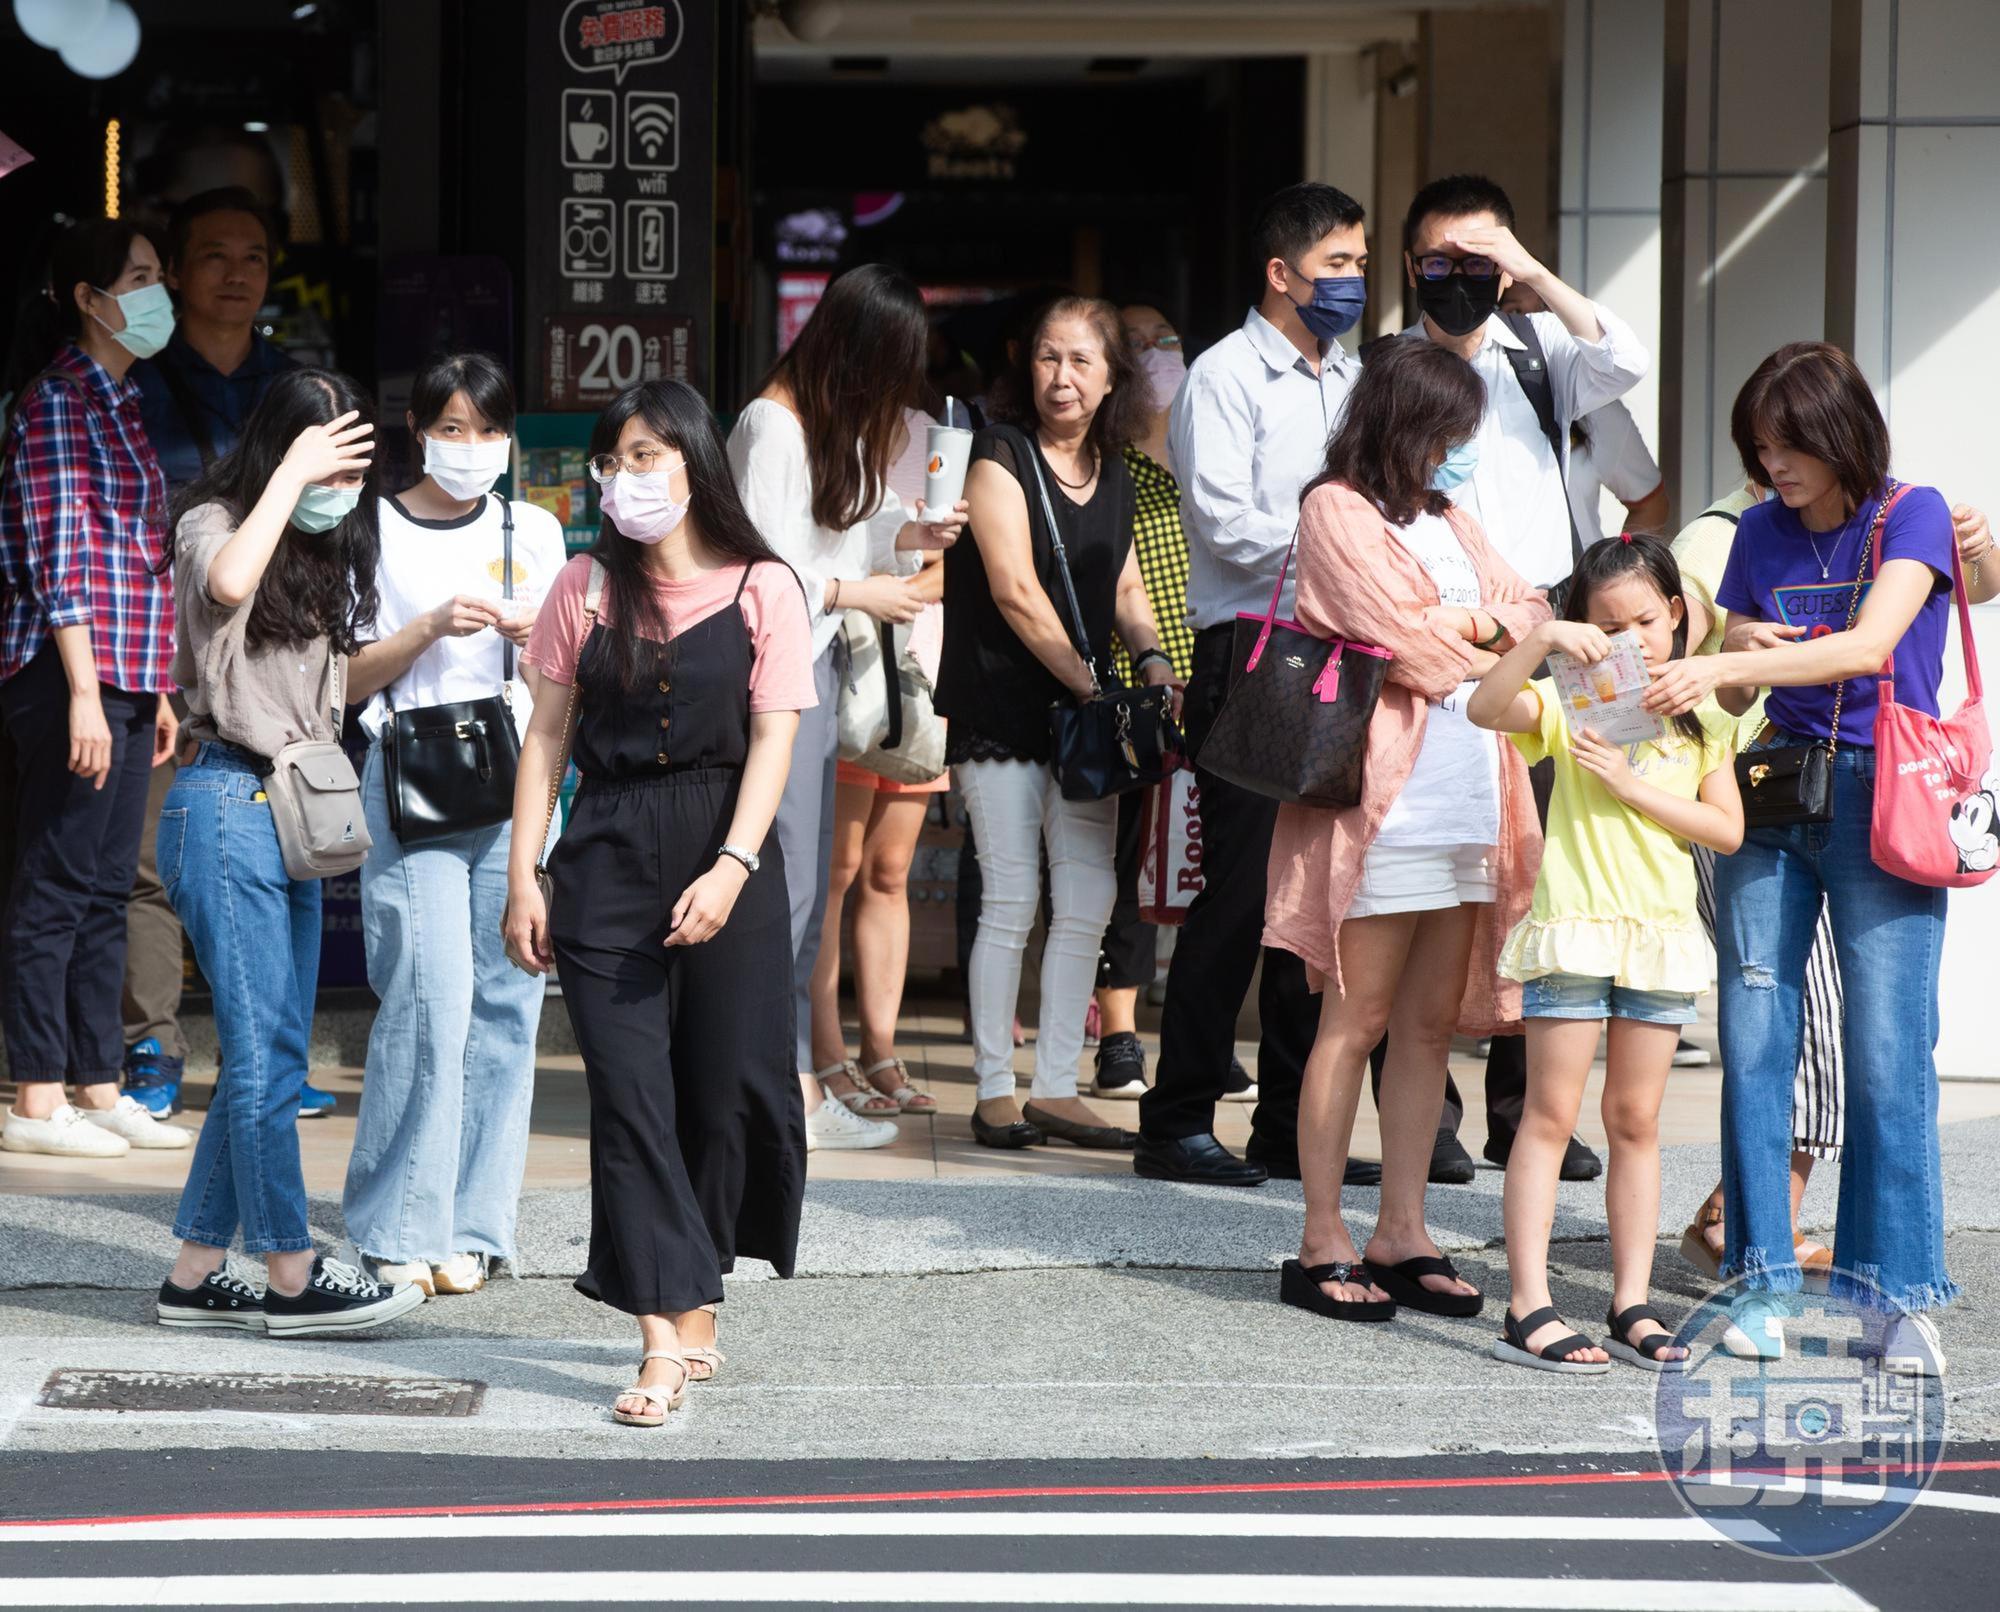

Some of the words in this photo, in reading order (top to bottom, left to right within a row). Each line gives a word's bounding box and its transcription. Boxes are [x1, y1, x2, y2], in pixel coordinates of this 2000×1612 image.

[579, 6, 666, 49] 免費服務
[573, 172, 605, 193] 咖啡
[637, 172, 668, 194] wifi
[573, 281, 604, 303] 維修
[579, 323, 643, 390] 20
[1176, 785, 1207, 893] Roots
